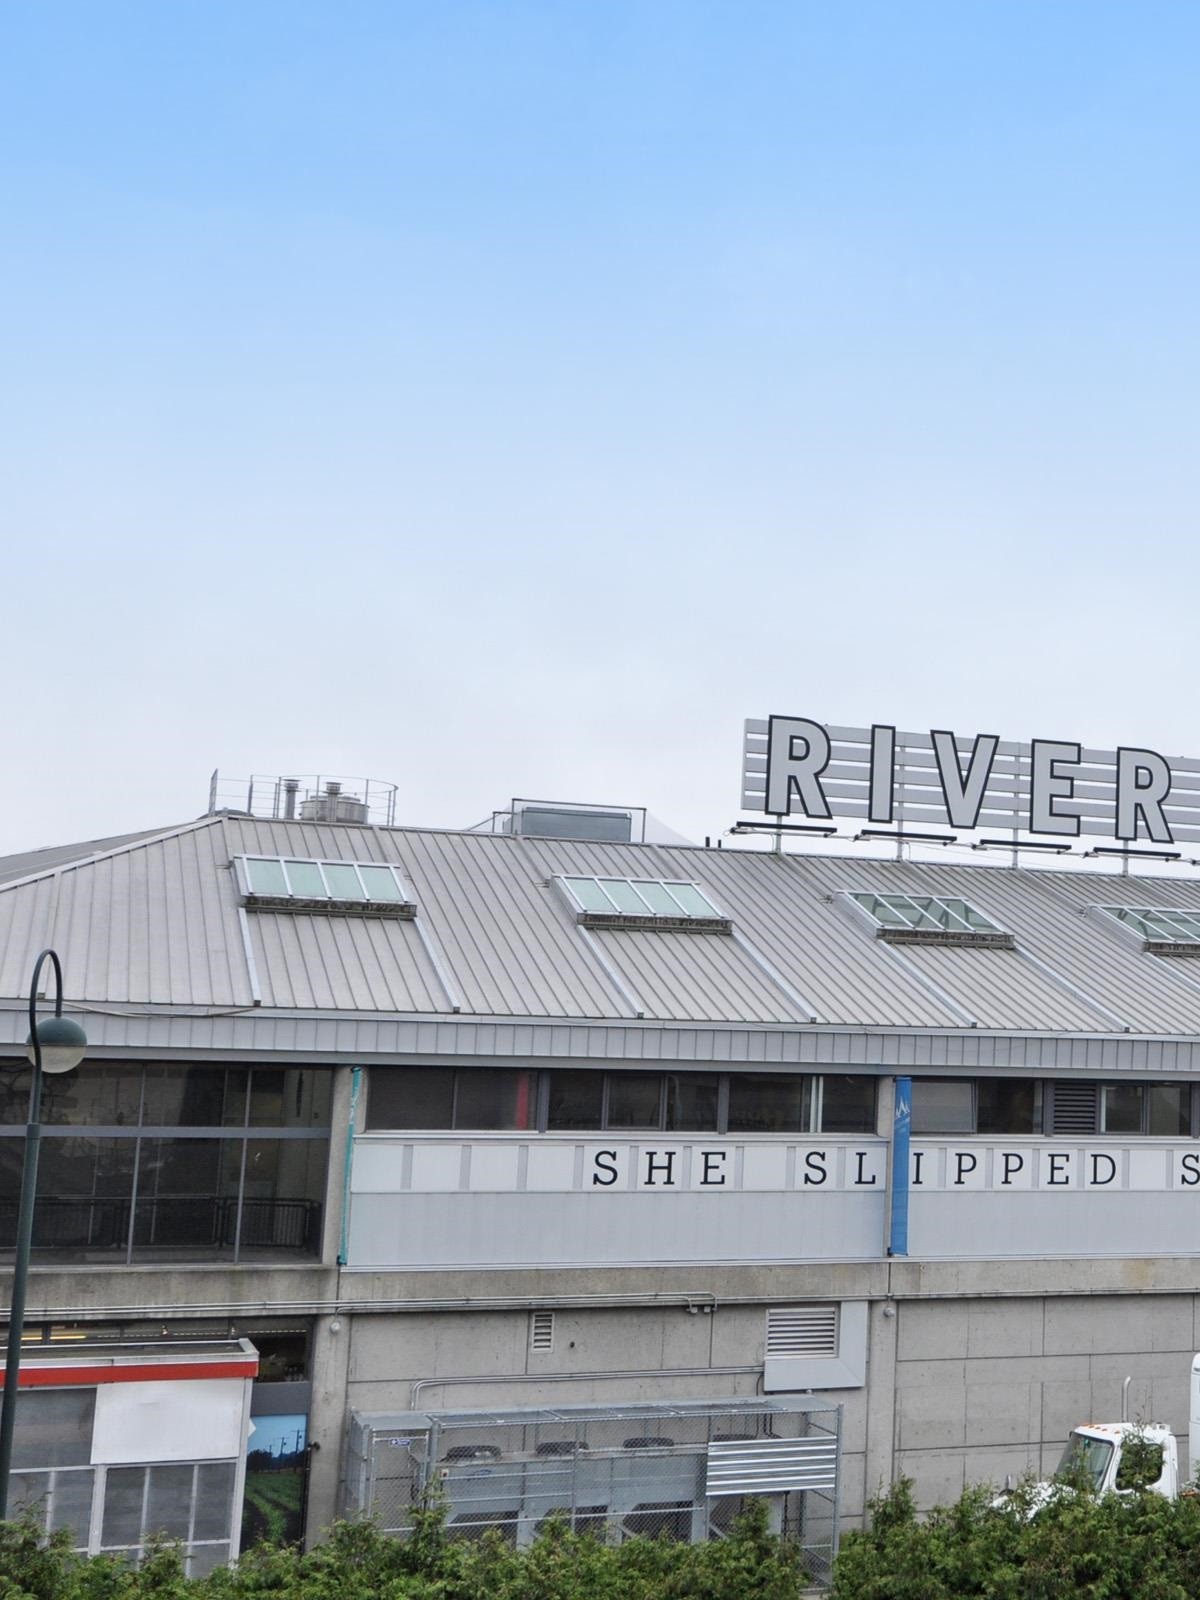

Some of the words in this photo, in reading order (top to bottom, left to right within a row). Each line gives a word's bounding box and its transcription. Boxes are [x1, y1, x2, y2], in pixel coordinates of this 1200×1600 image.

[765, 714, 1175, 844] RIVER
[592, 1150, 726, 1186] SHE
[804, 1151, 1117, 1186] SLIPPED
